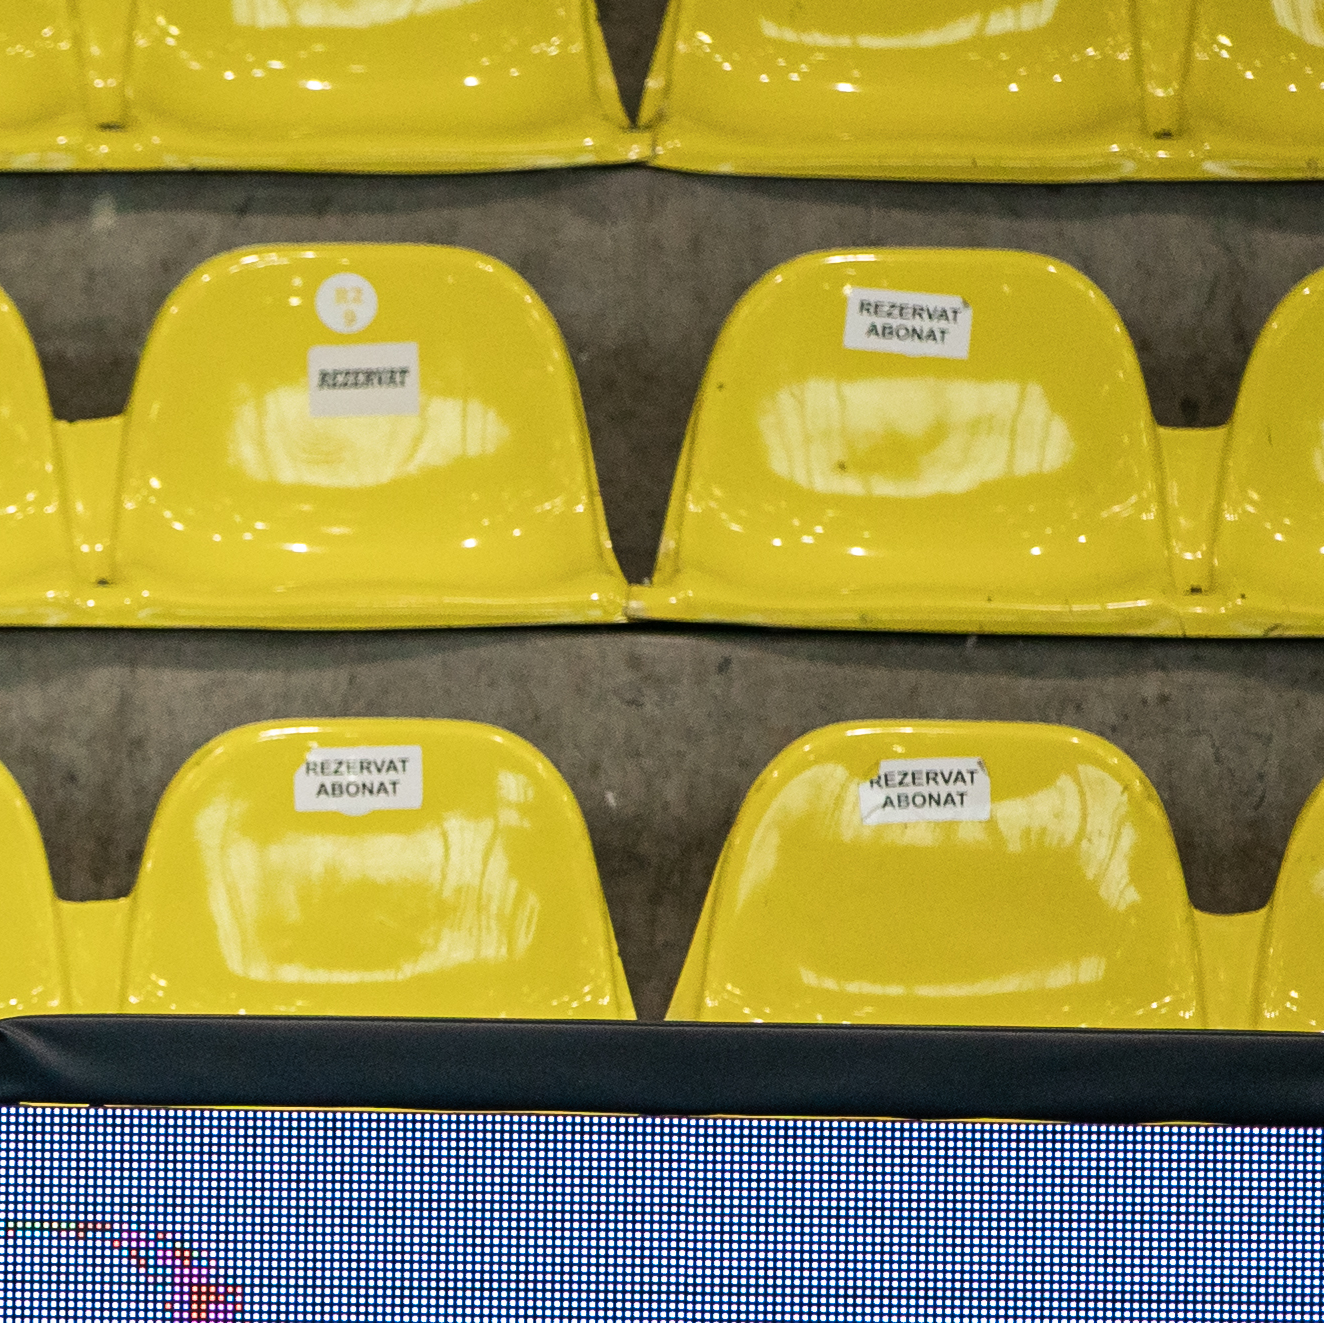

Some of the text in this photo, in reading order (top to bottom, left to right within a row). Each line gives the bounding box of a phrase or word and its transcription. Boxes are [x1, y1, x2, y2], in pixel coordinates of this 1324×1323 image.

[858, 298, 962, 325] REZERVAT
[865, 321, 950, 345] ABONAT
[305, 756, 411, 777] REZERVAT
[316, 778, 401, 799] ABONAT
[869, 767, 979, 790] REZERVAT
[882, 790, 968, 810] ABONAT
